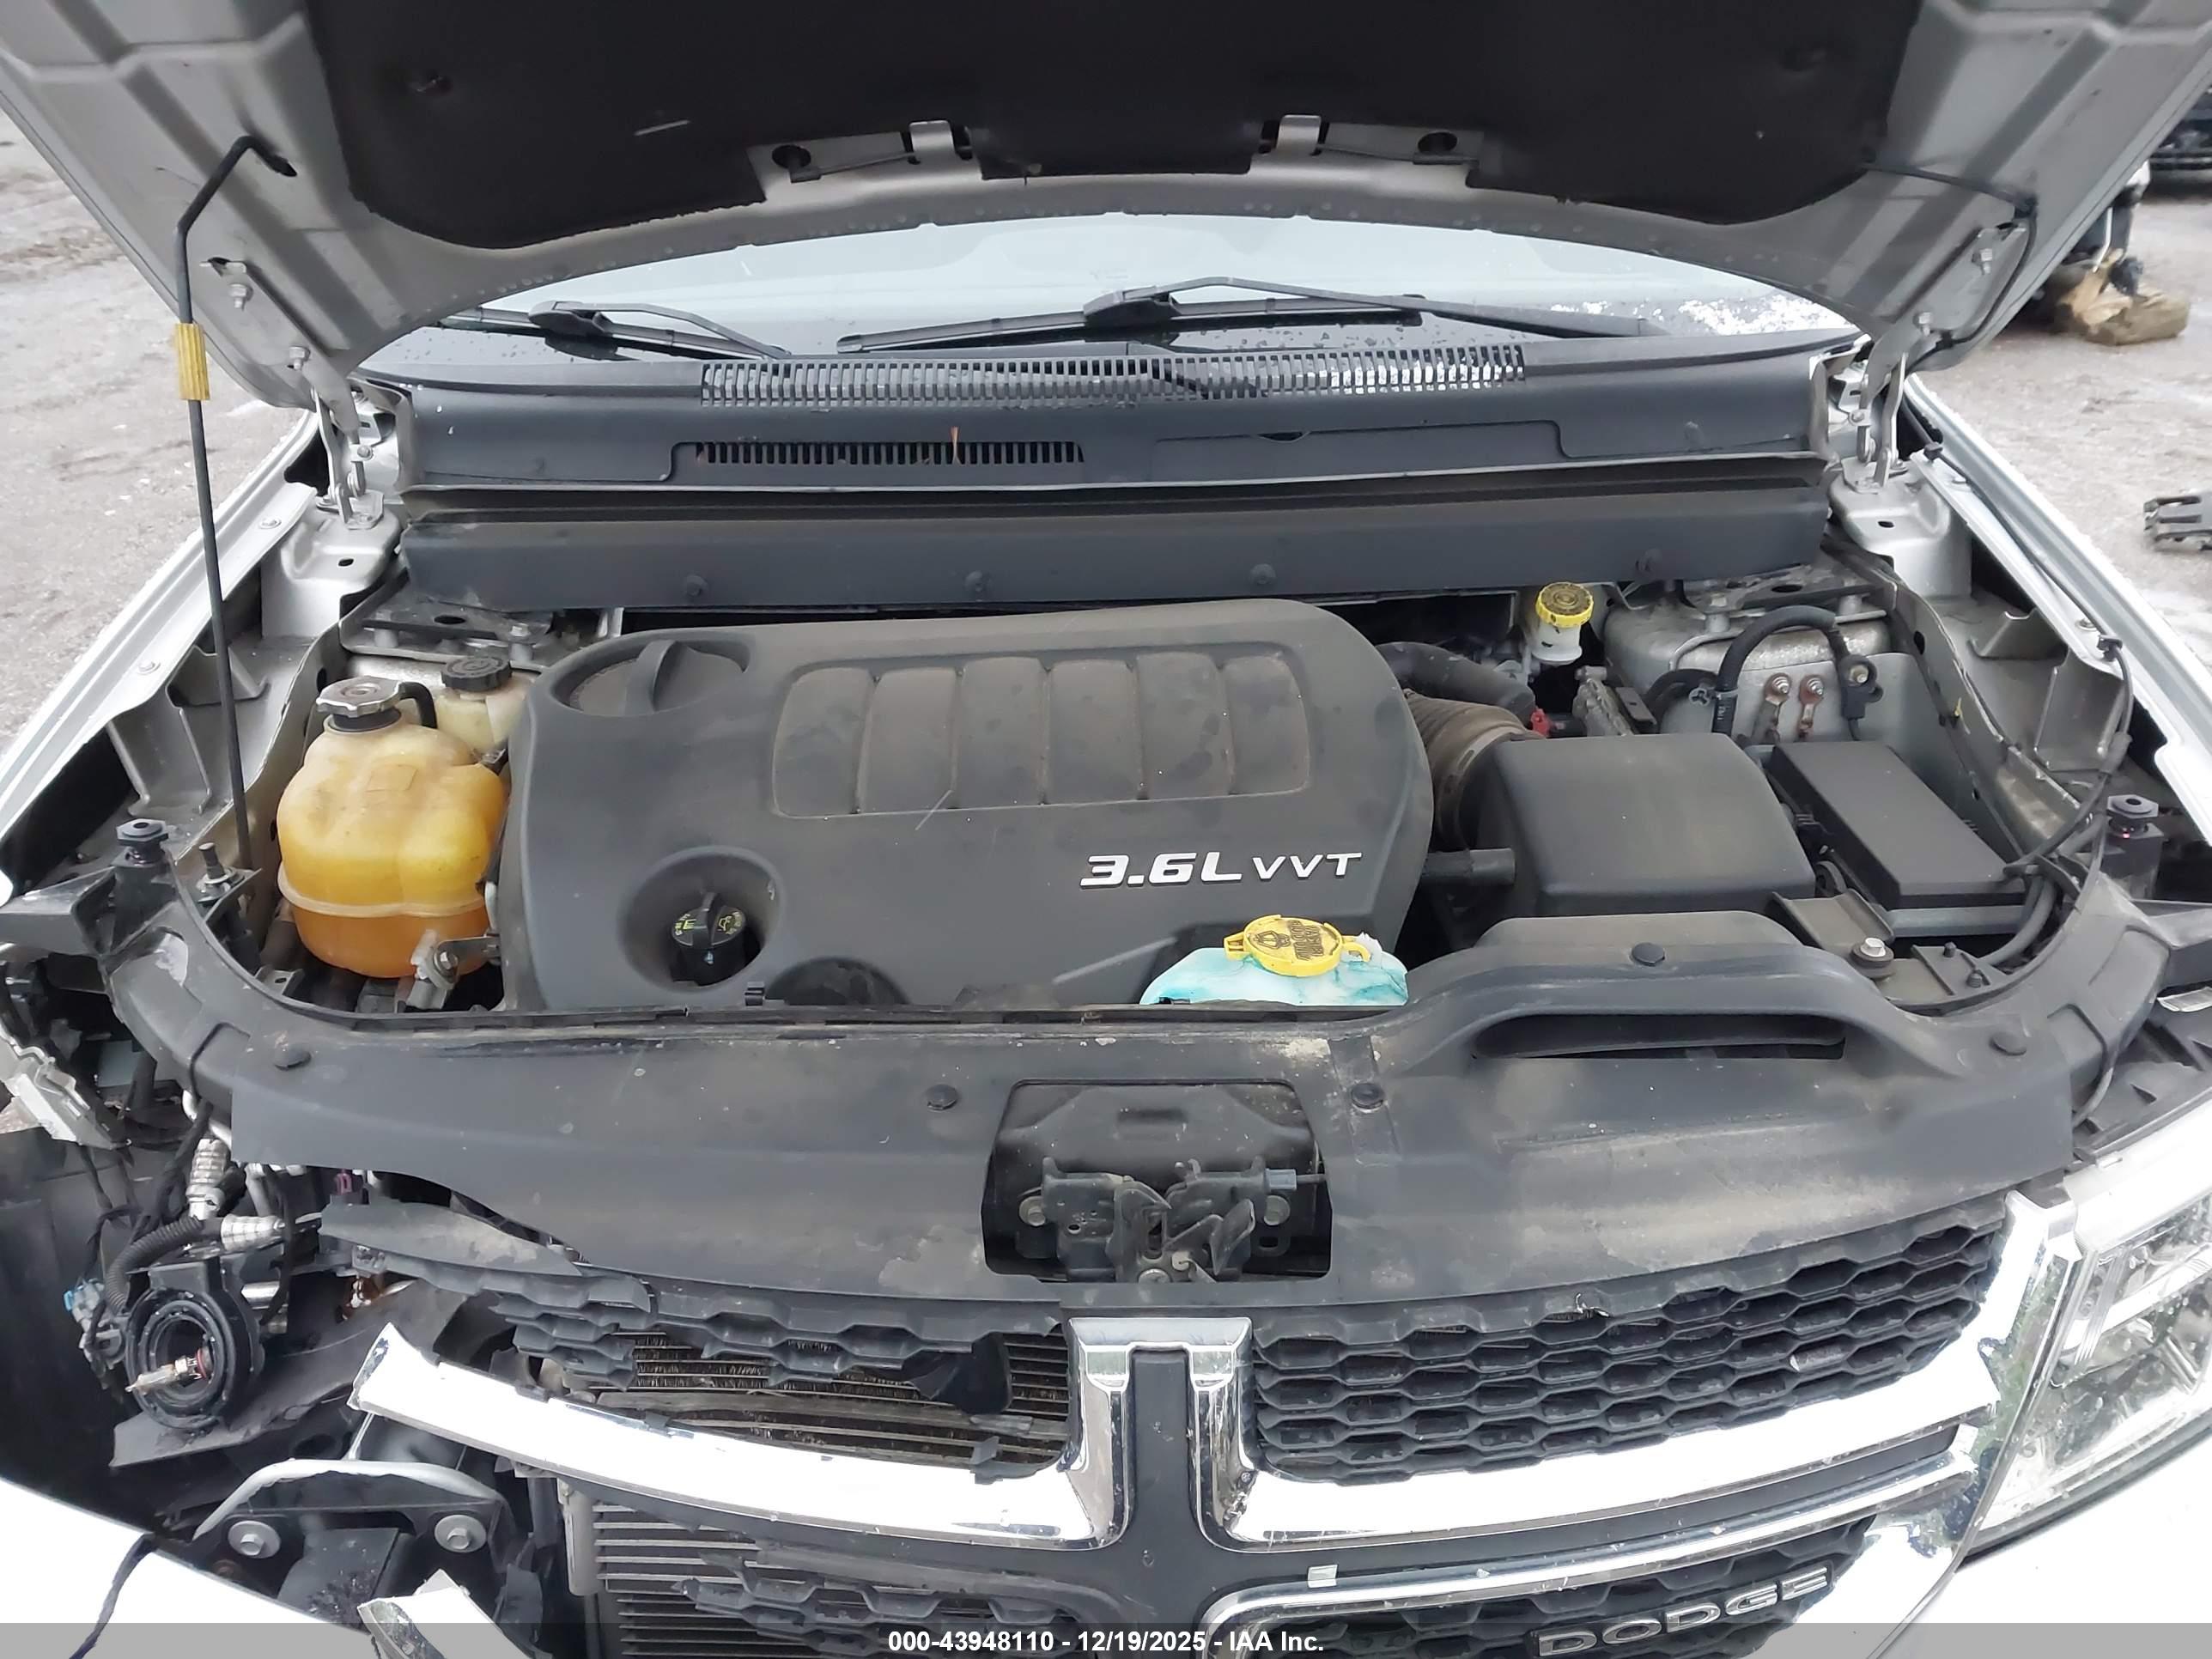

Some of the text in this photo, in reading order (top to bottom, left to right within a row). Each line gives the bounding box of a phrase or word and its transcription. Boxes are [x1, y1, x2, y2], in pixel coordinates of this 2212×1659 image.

[1079, 852, 1363, 888] 3.6L VVT
[1537, 1565, 1830, 1657] DODGE
